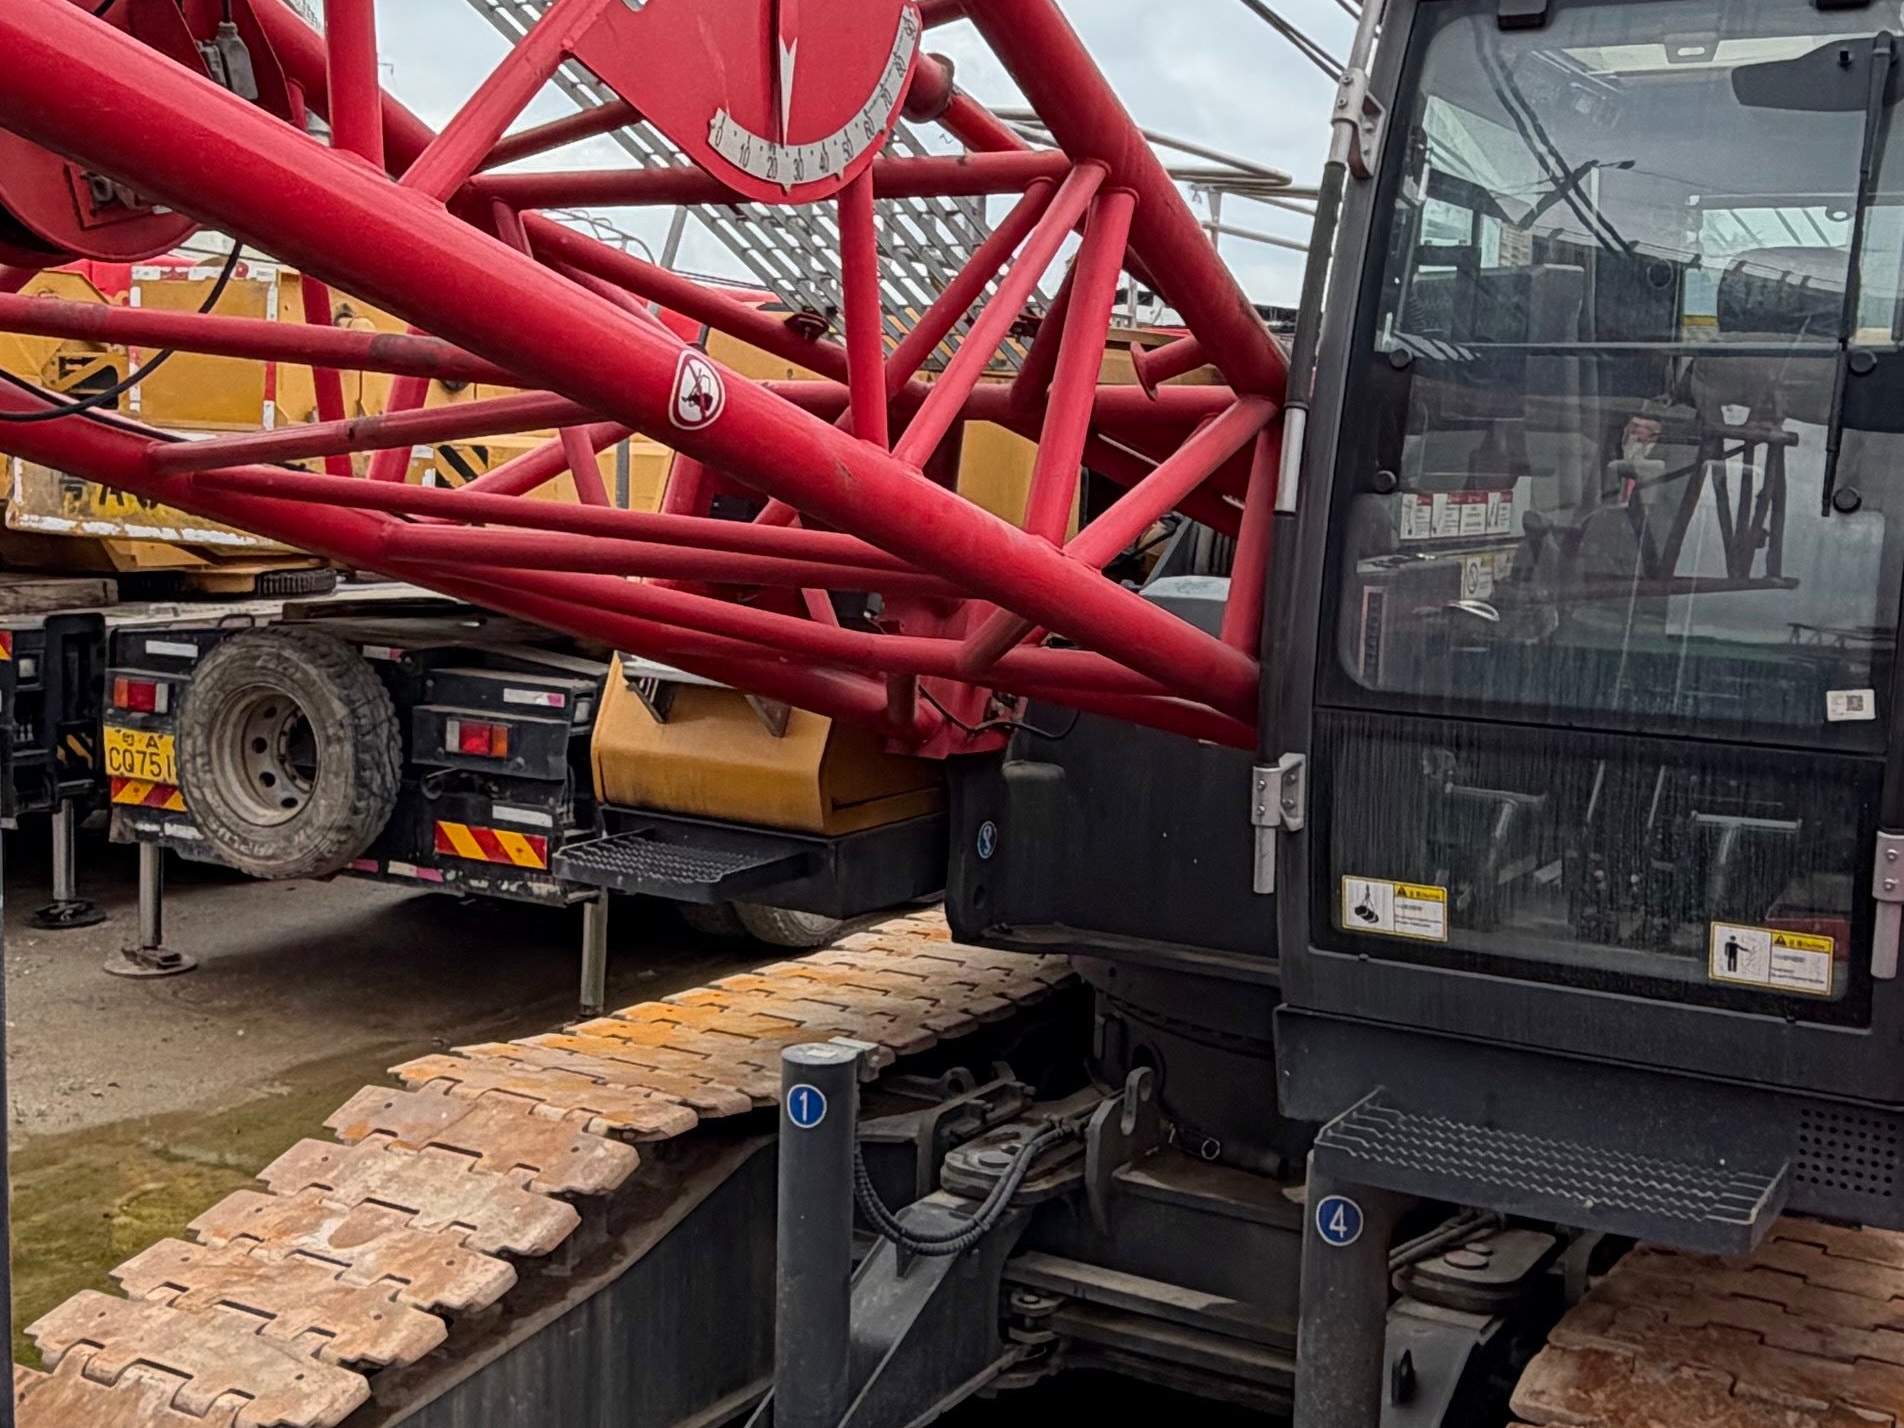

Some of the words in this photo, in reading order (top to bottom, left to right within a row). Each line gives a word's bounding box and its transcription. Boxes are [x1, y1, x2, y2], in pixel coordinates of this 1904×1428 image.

[738, 143, 751, 169] 10
[766, 156, 778, 180] 20
[793, 158, 805, 182] 30
[1329, 1203, 1348, 1239] 4
